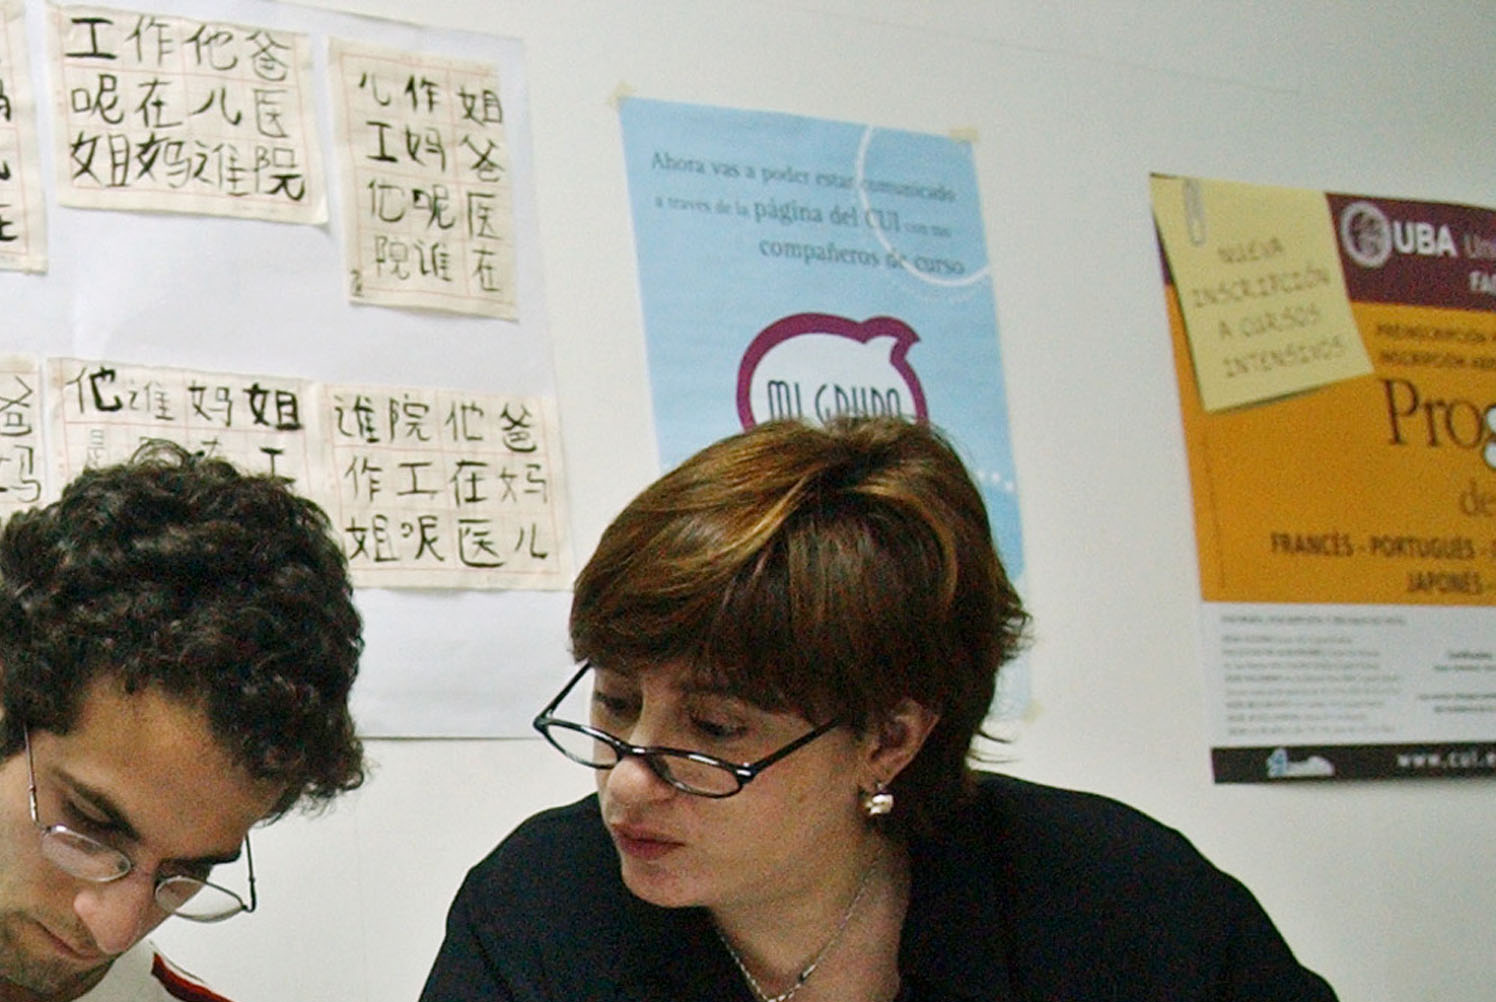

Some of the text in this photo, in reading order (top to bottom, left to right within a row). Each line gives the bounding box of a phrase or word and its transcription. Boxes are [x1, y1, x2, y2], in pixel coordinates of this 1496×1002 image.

[652, 151, 705, 174] Ahora
[711, 161, 740, 178] vas
[761, 166, 809, 185] poder
[754, 198, 823, 225] página
[830, 203, 858, 227] del
[758, 238, 880, 268] compañeros
[914, 255, 966, 276] curso
[1393, 220, 1459, 258] UBA
